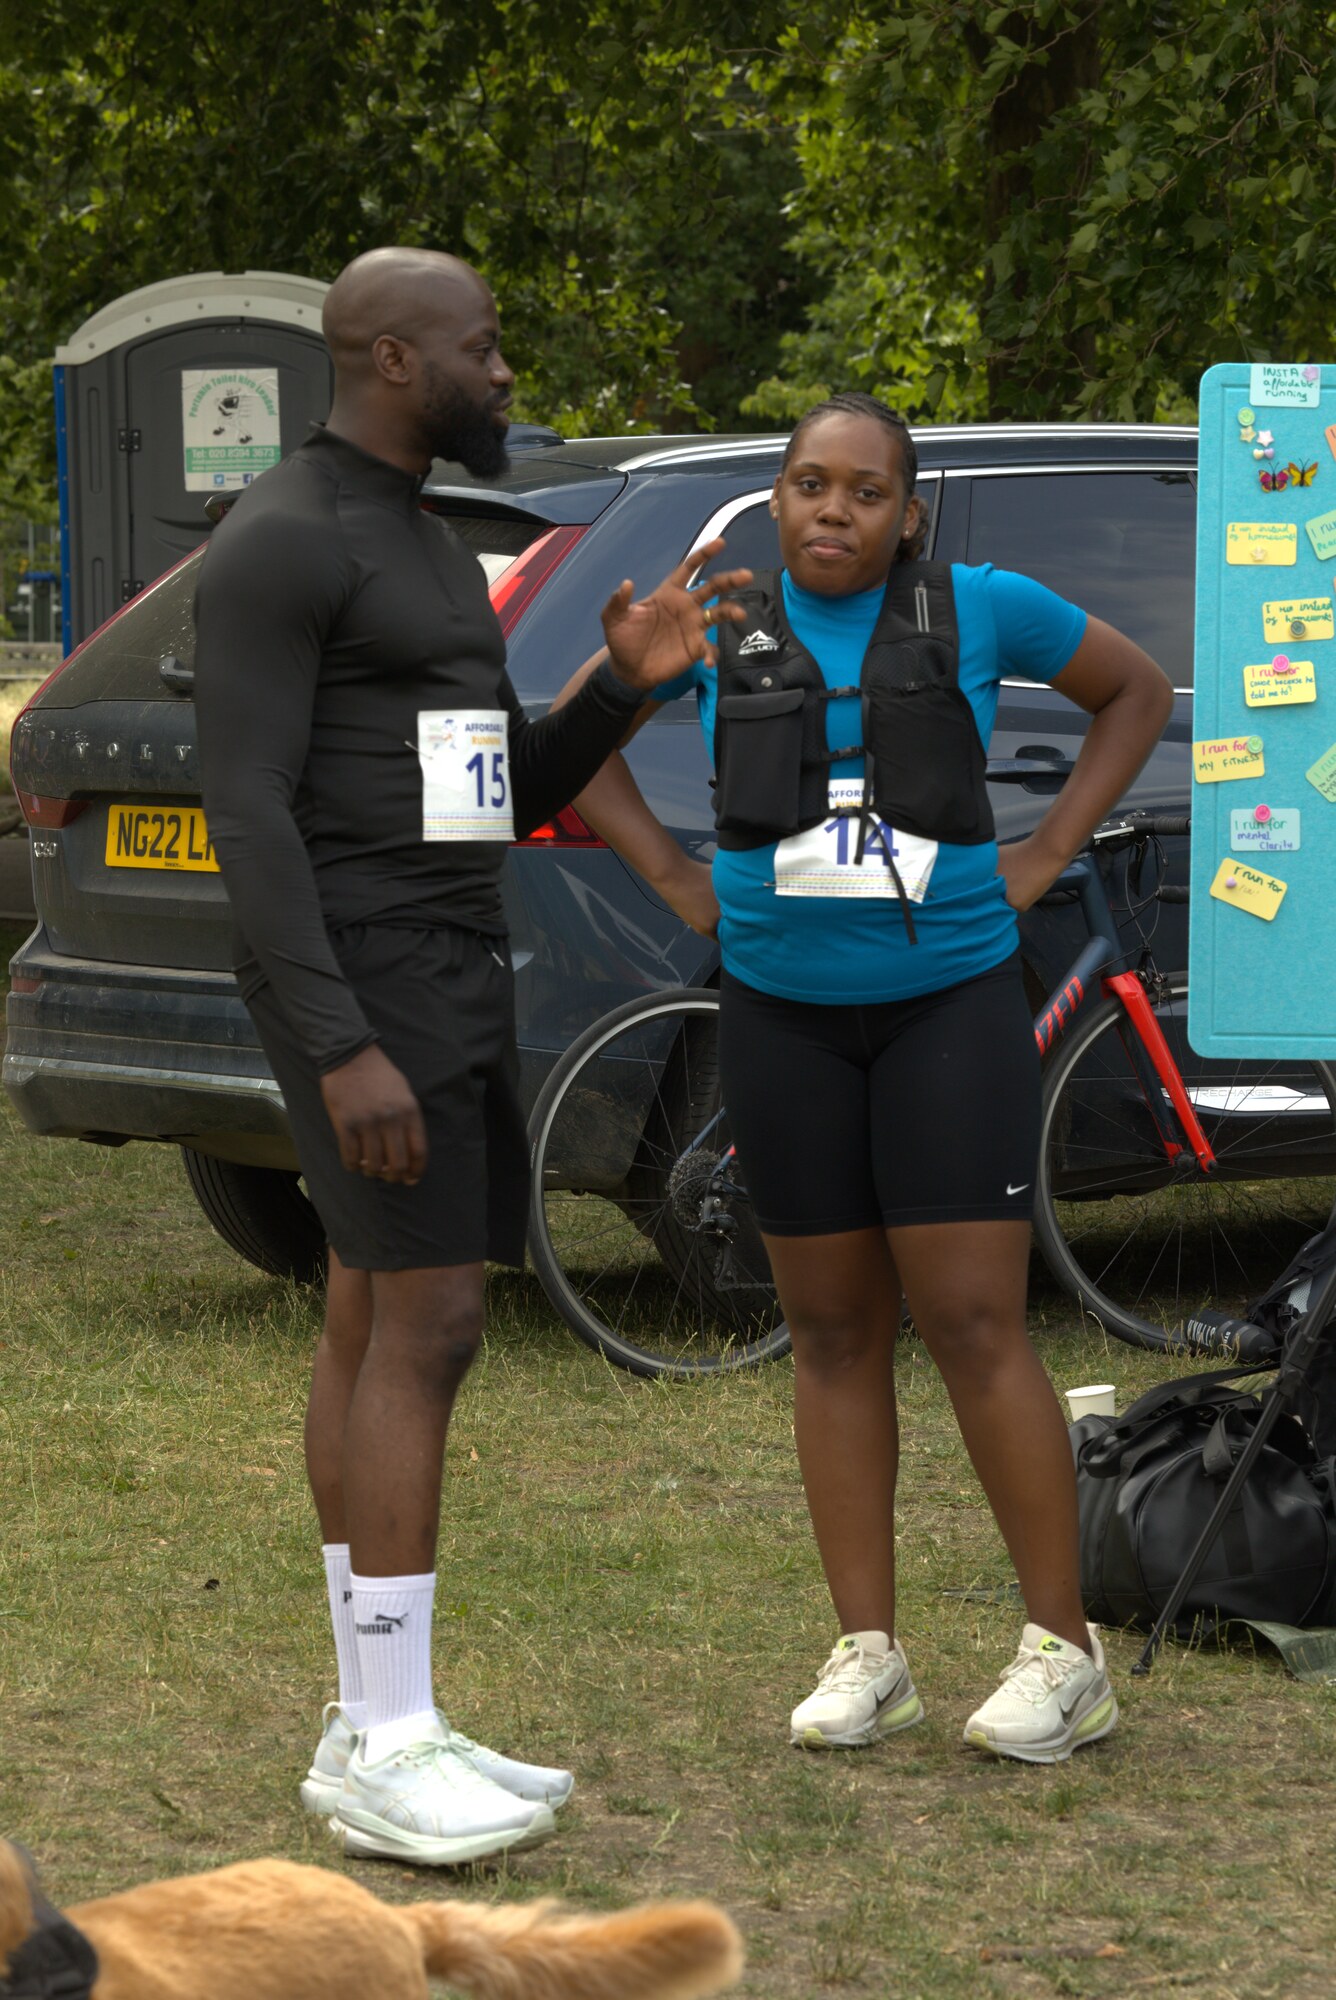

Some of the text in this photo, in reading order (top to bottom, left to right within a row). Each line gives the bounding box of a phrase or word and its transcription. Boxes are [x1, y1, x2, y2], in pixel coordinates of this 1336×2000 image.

[1265, 389, 1308, 402] running
[1202, 744, 1206, 756] I
[1208, 743, 1229, 754] run
[465, 752, 507, 808] 15
[1235, 820, 1239, 831] I
[1268, 816, 1288, 831] for
[116, 811, 182, 860] NG22
[824, 816, 900, 866] 14
[1200, 1088, 1273, 1098] RECHARGE
